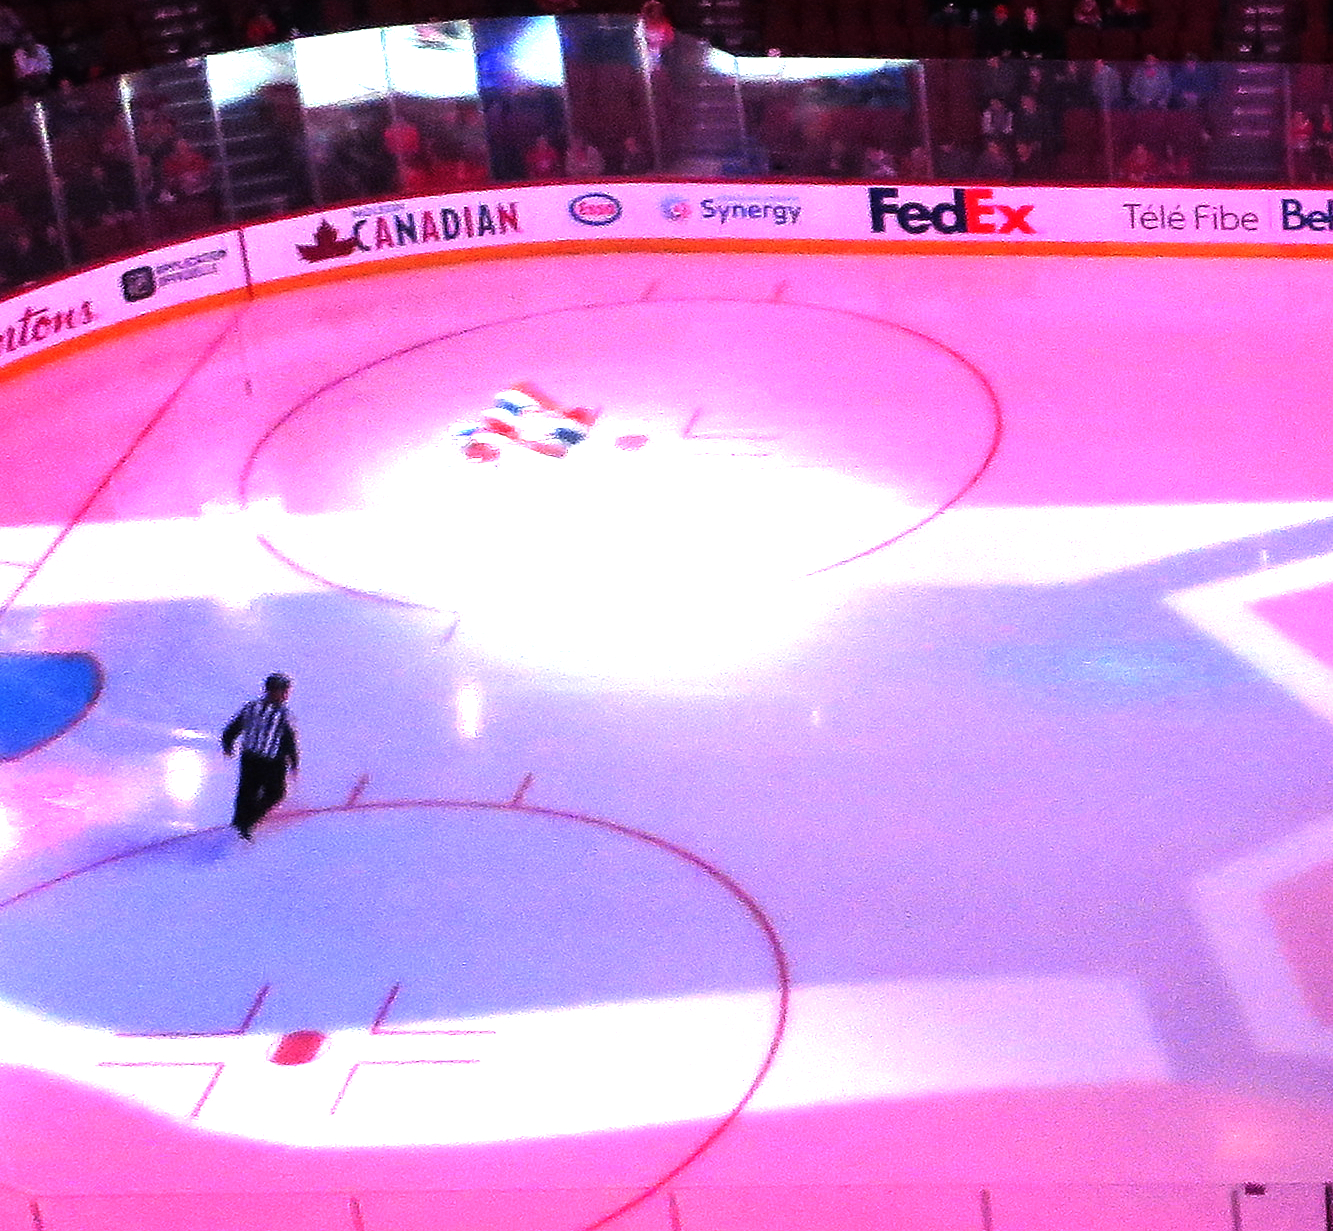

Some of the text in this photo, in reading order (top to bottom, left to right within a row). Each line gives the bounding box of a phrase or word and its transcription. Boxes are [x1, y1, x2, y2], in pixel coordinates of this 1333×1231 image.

[353, 201, 520, 251] CANADIAN
[700, 198, 801, 226] Synergy
[869, 187, 1036, 234] FedEx
[1123, 203, 1259, 231] Télé Fibe
